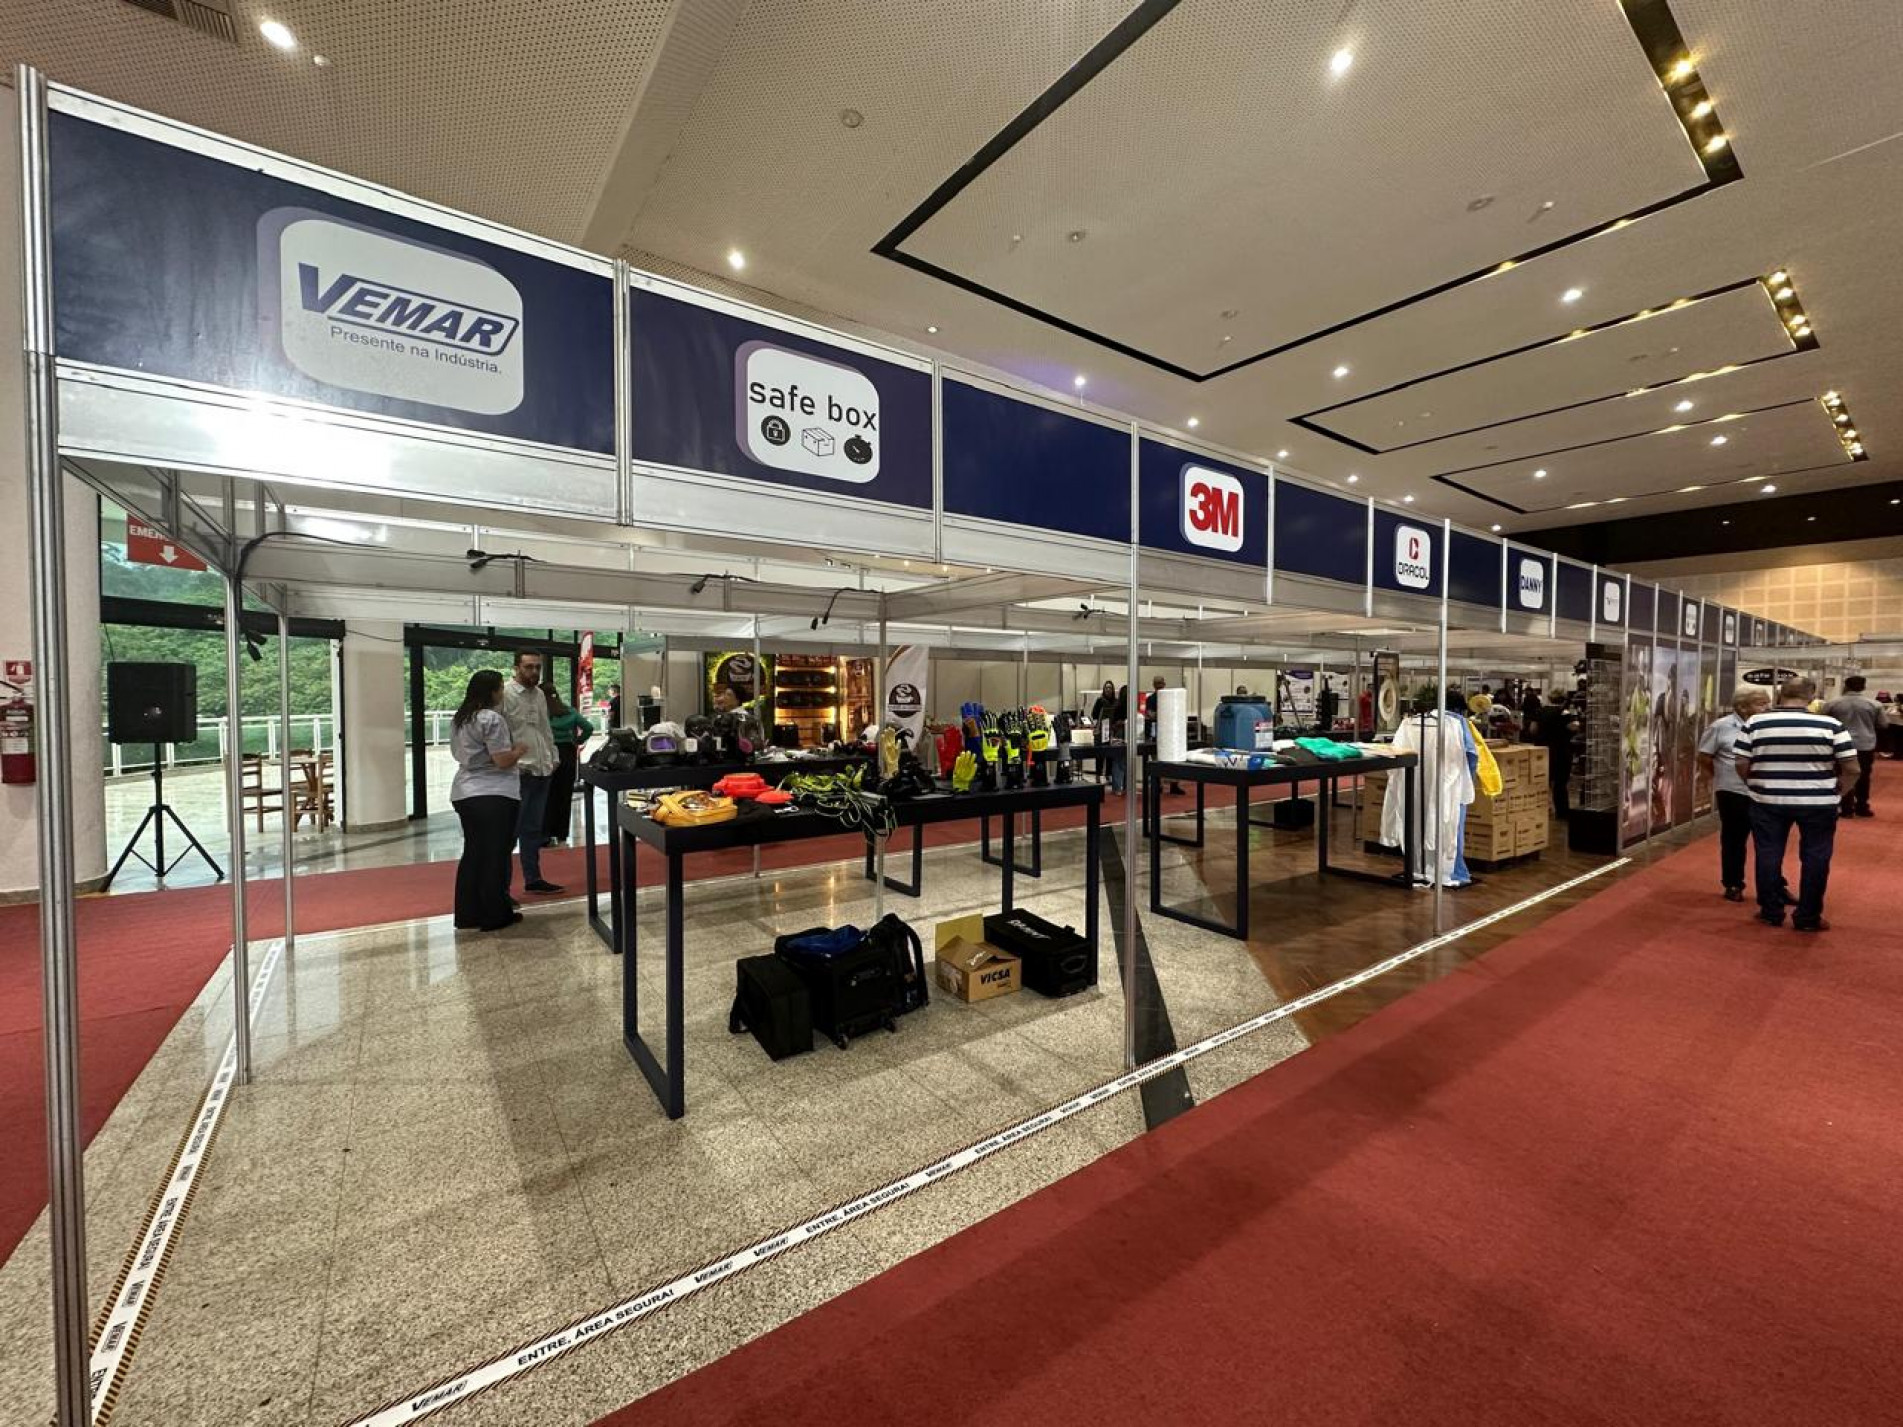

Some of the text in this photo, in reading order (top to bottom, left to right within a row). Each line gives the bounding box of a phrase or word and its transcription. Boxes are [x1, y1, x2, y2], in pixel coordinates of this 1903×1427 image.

[298, 262, 506, 349] VEMAR
[330, 326, 502, 375] Presente na Indústria.
[749, 381, 878, 431] safe box
[1188, 482, 1240, 538] 3M
[980, 968, 1011, 985] VICSA
[693, 1260, 734, 1285] VEMAR
[517, 1288, 675, 1367] ENTRE, ÁREA SEGURA!
[411, 1379, 469, 1413] VEMAR
